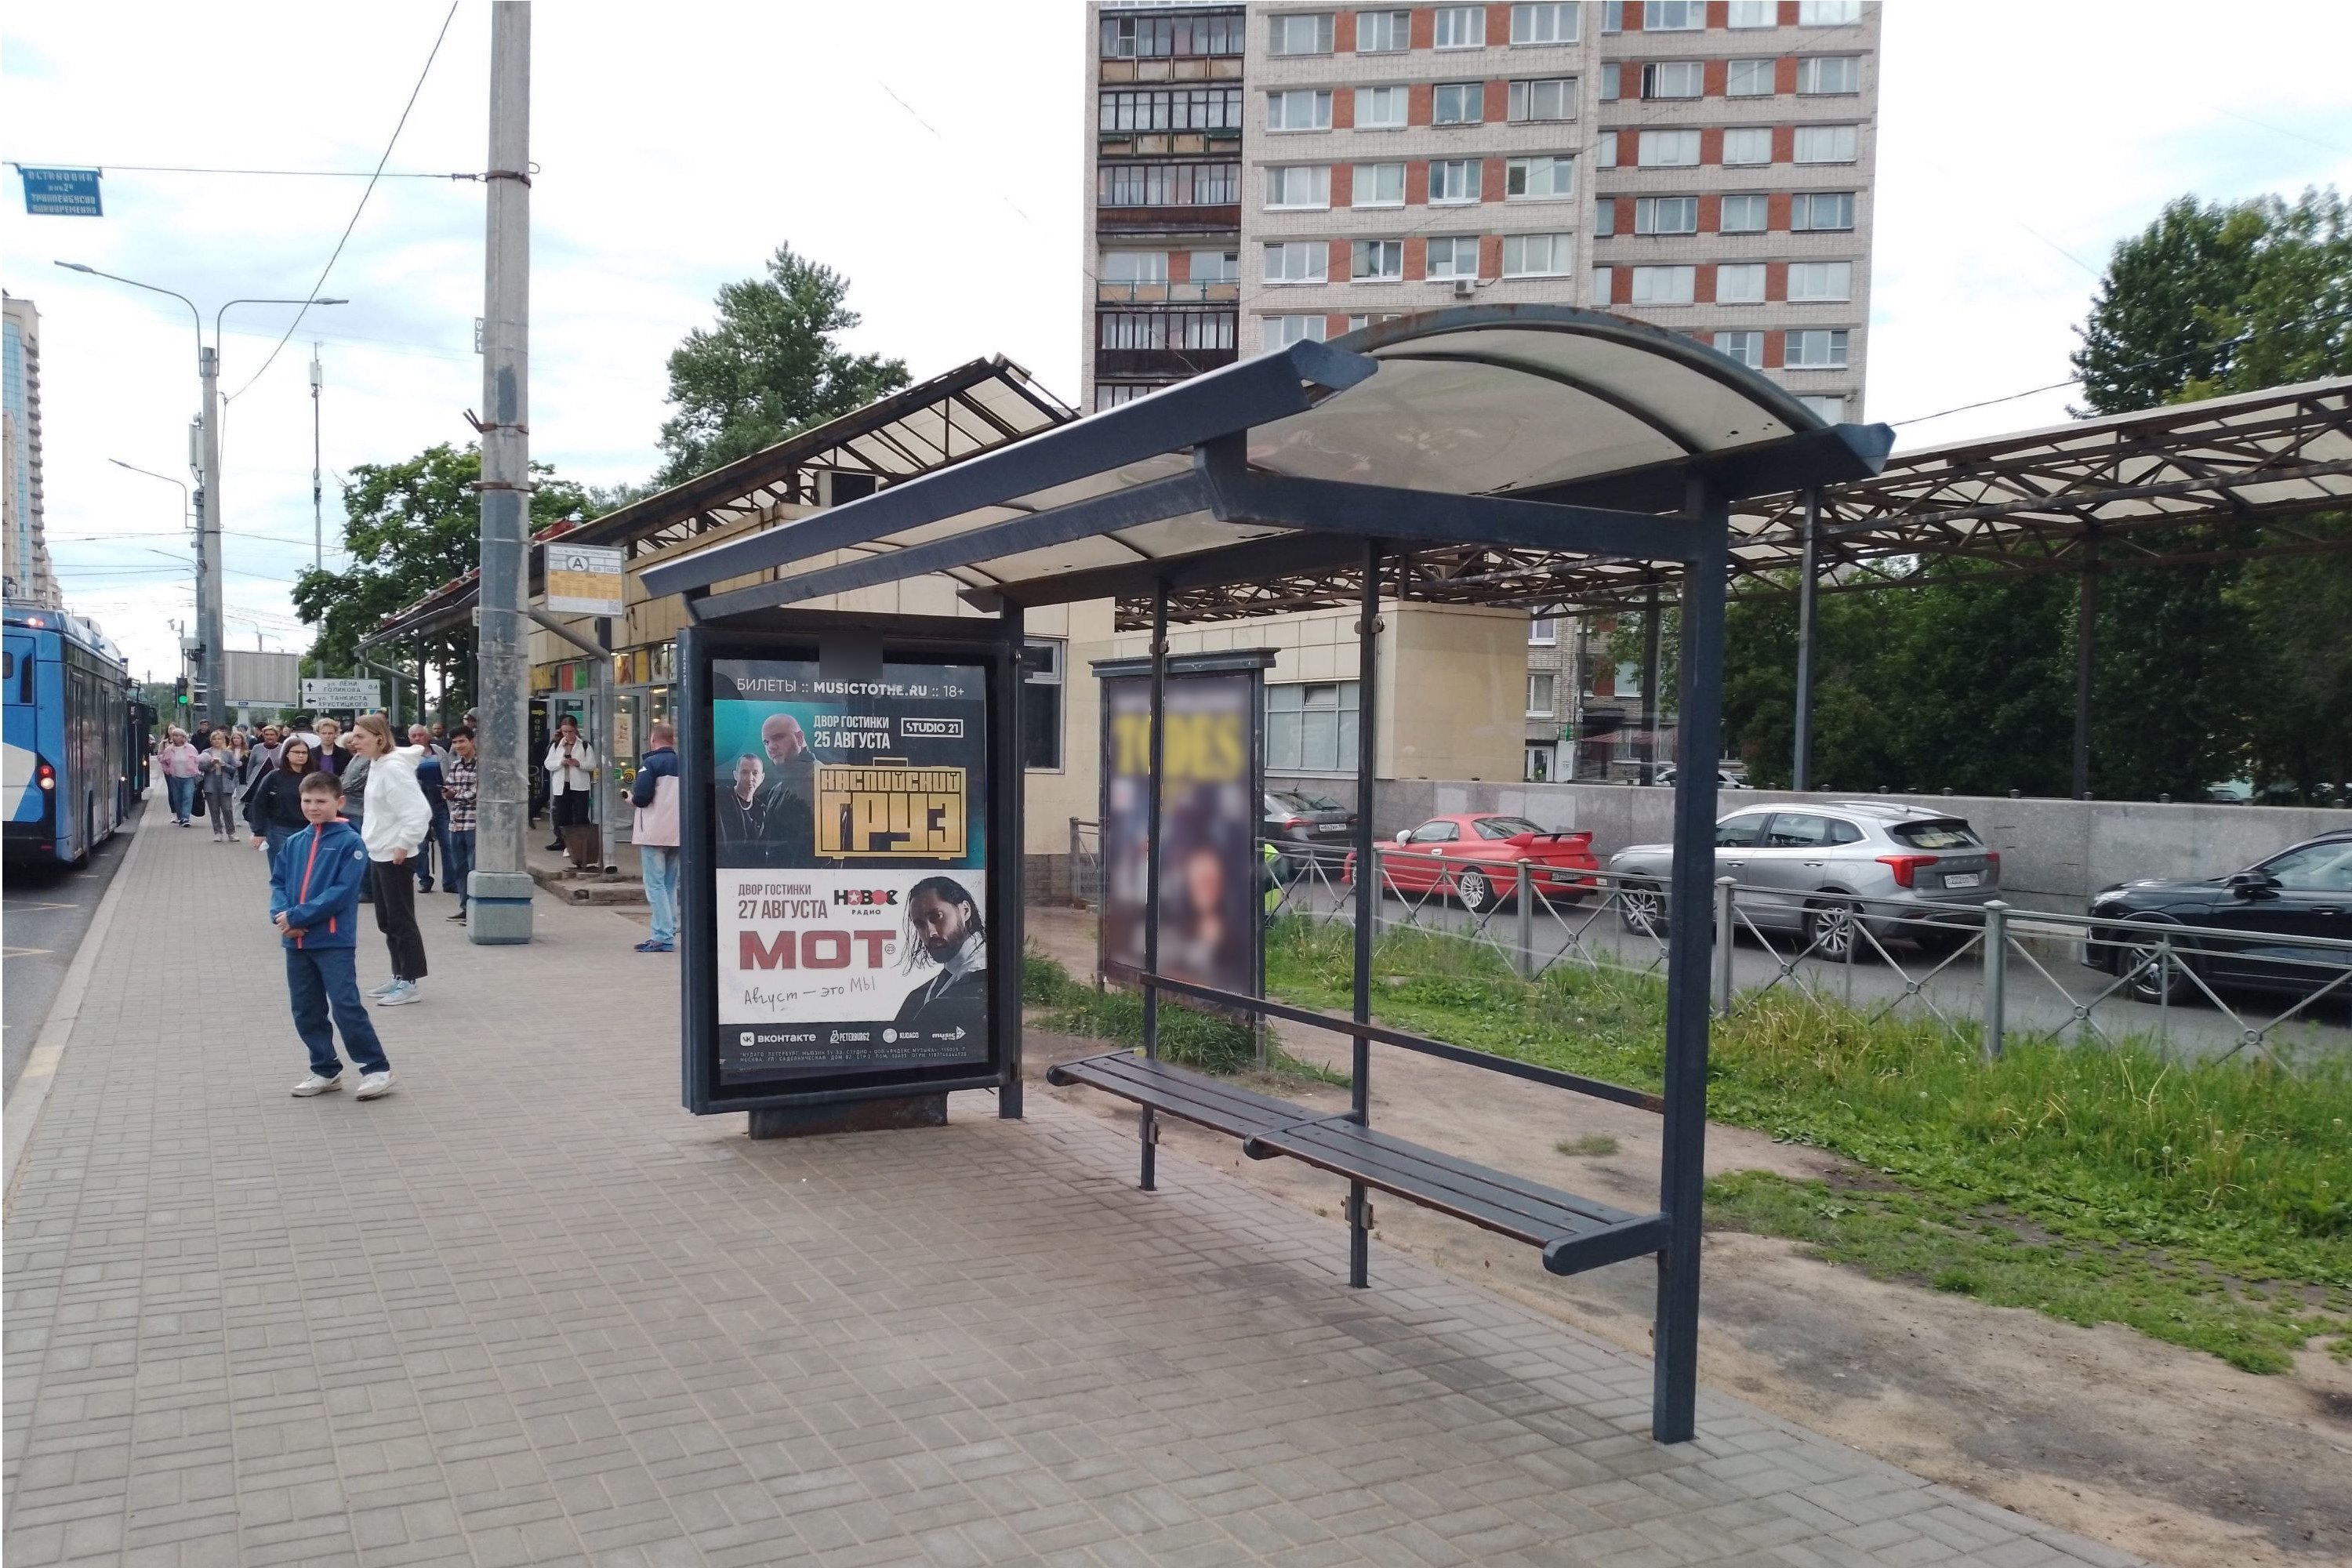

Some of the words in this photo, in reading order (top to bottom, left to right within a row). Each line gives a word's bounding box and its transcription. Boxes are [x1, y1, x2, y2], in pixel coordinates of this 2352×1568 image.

[737, 678, 797, 692] БИЛЕТЫ
[813, 681, 927, 696] MUSICTOTHE.RU
[943, 685, 965, 698] 18+
[813, 715, 839, 728] ДВОР
[841, 716, 889, 729] ГОСТИНКИ
[906, 722, 946, 733] STUDIO
[948, 723, 958, 734] 21
[814, 731, 830, 748] 25
[833, 731, 891, 750] АВГУСТА
[821, 770, 960, 792] КАСПИЙСКИЙ
[822, 792, 960, 851] ГРУЗ
[739, 884, 763, 896] ДВОР
[765, 884, 811, 895] ГОСТИНКИ
[739, 900, 757, 919] 27
[761, 900, 828, 919] АВГУСТА
[739, 930, 897, 971] МОТ
[744, 986, 797, 1012] Август
[820, 986, 844, 997] это
